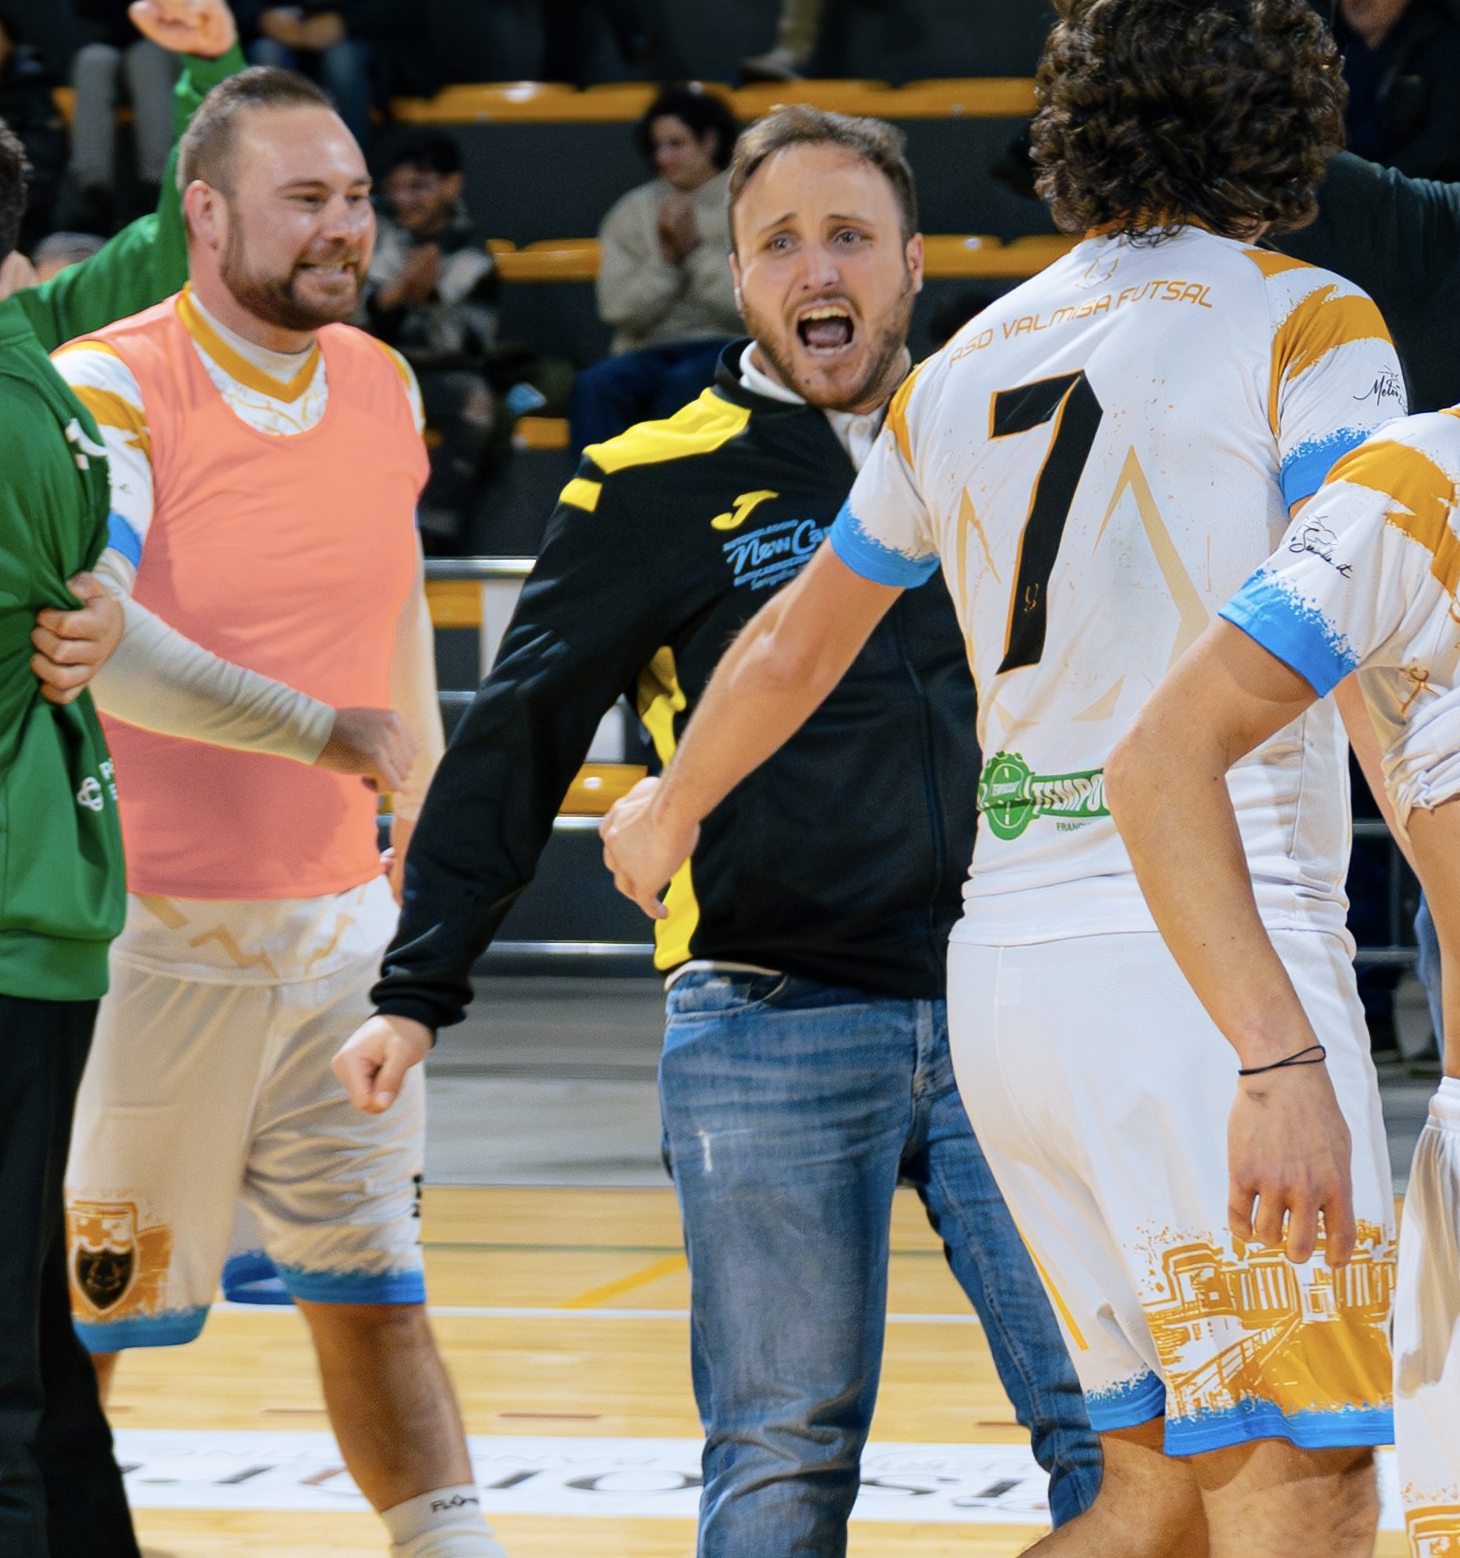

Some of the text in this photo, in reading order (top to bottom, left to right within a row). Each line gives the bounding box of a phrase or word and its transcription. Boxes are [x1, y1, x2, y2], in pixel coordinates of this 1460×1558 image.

[948, 279, 1213, 368] ASD VALMISA FUTSAL
[988, 369, 1104, 676] 7
